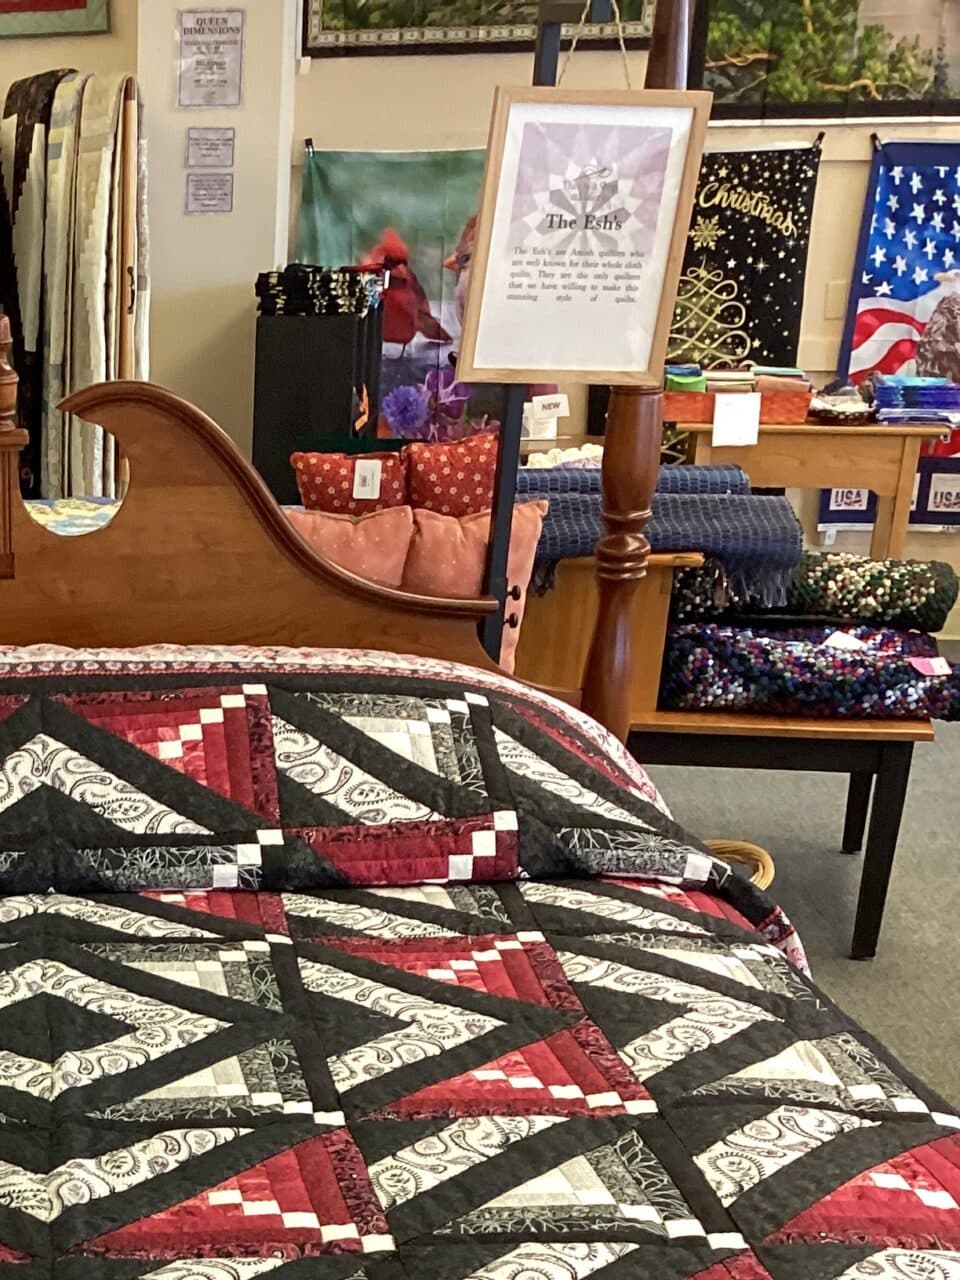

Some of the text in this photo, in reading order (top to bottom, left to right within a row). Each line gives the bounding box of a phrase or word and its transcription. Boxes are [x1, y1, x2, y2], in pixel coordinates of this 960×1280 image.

[196, 17, 228, 26] QUEEN
[183, 26, 241, 35] DIMENSIONS
[699, 182, 798, 239] Christmas
[546, 213, 623, 231] The Esh's
[526, 258, 540, 266] well
[543, 259, 567, 267] known
[569, 259, 579, 268] for
[581, 260, 599, 268] their
[602, 261, 622, 269] whole
[624, 261, 643, 269] cloth
[538, 269, 555, 279] They
[576, 271, 589, 279] the
[593, 272, 609, 281] only
[508, 281, 523, 289] that
[541, 282, 558, 290] have
[561, 282, 587, 292] willing
[602, 283, 621, 291] make
[625, 284, 639, 292] this
[556, 294, 572, 303] style
[590, 294, 598, 303] of
[541, 402, 561, 411] NEW
[834, 489, 863, 507] USA
